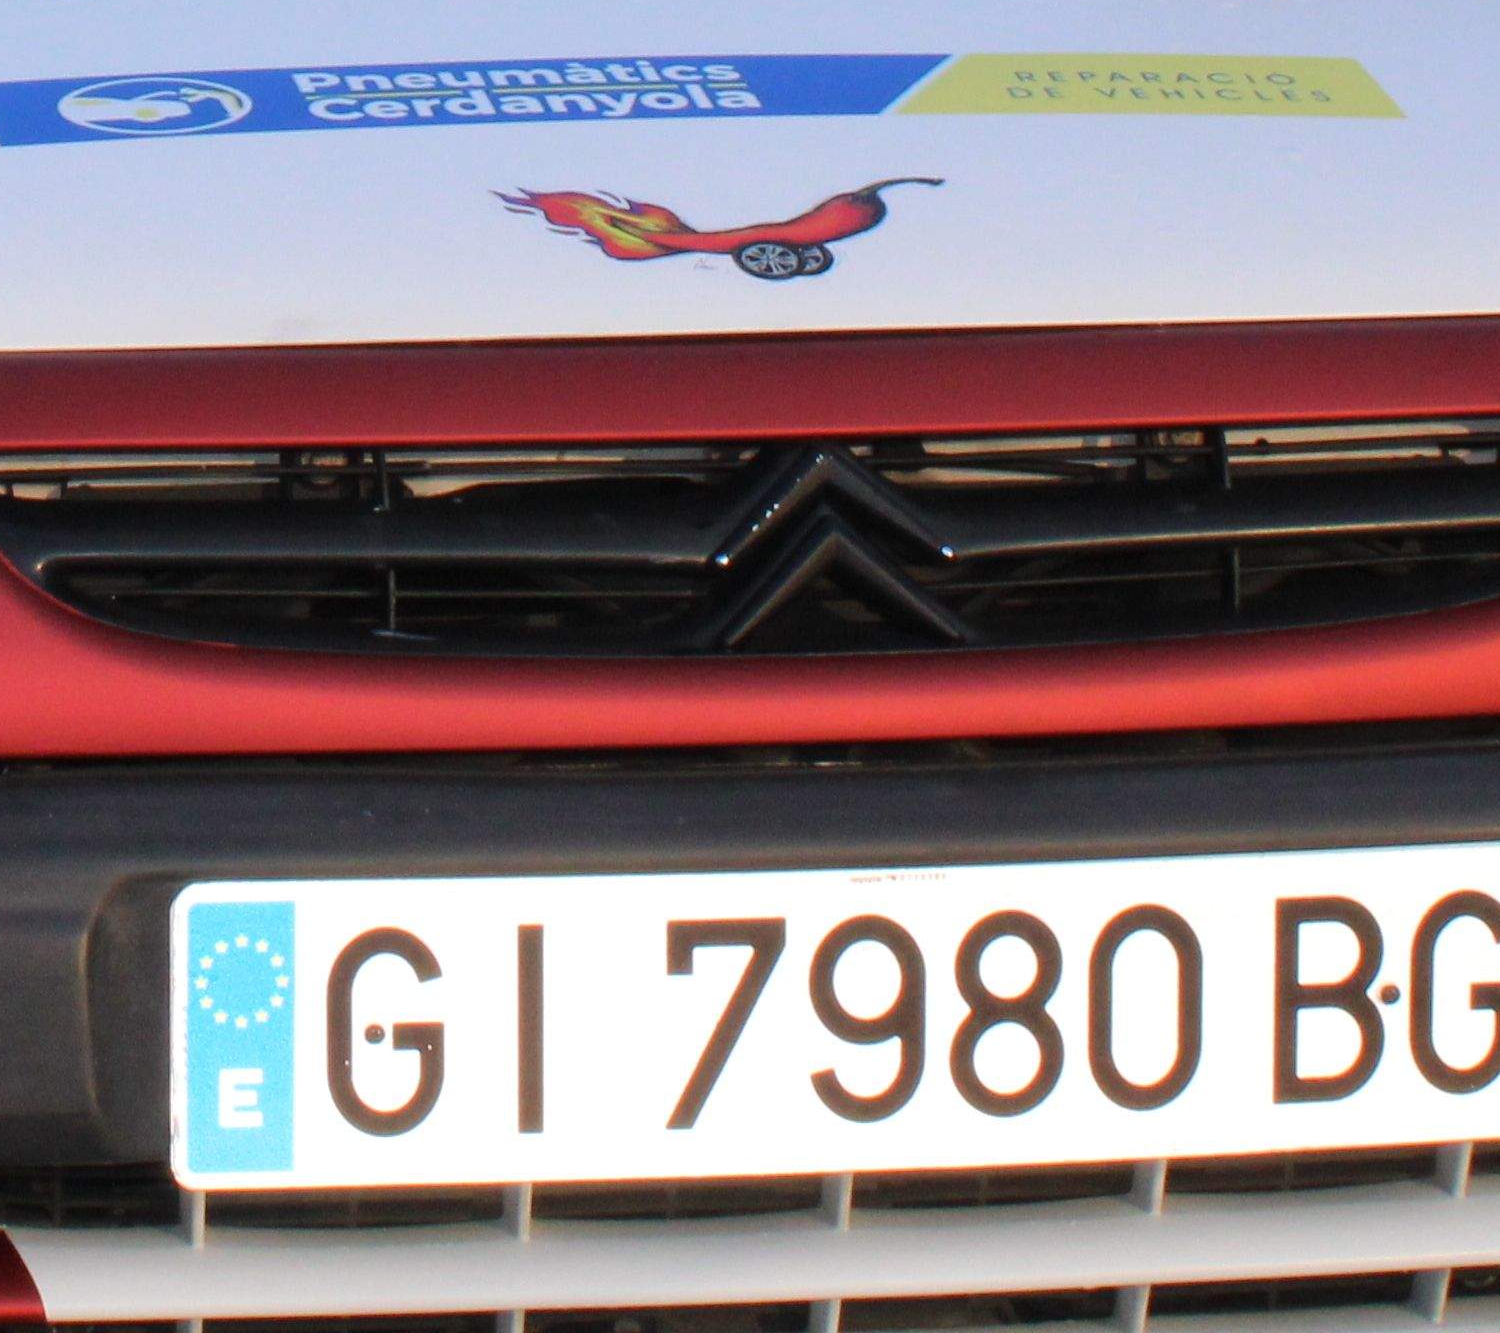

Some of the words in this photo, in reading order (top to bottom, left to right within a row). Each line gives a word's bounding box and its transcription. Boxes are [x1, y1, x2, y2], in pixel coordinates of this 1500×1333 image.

[291, 60, 742, 94] Pneumàtics
[1006, 87, 1065, 101] DE
[1096, 87, 1333, 102] VEHICLES
[308, 83, 763, 121] Cerdanyola
[665, 903, 1203, 1131] 7980
[216, 1068, 265, 1130] E
